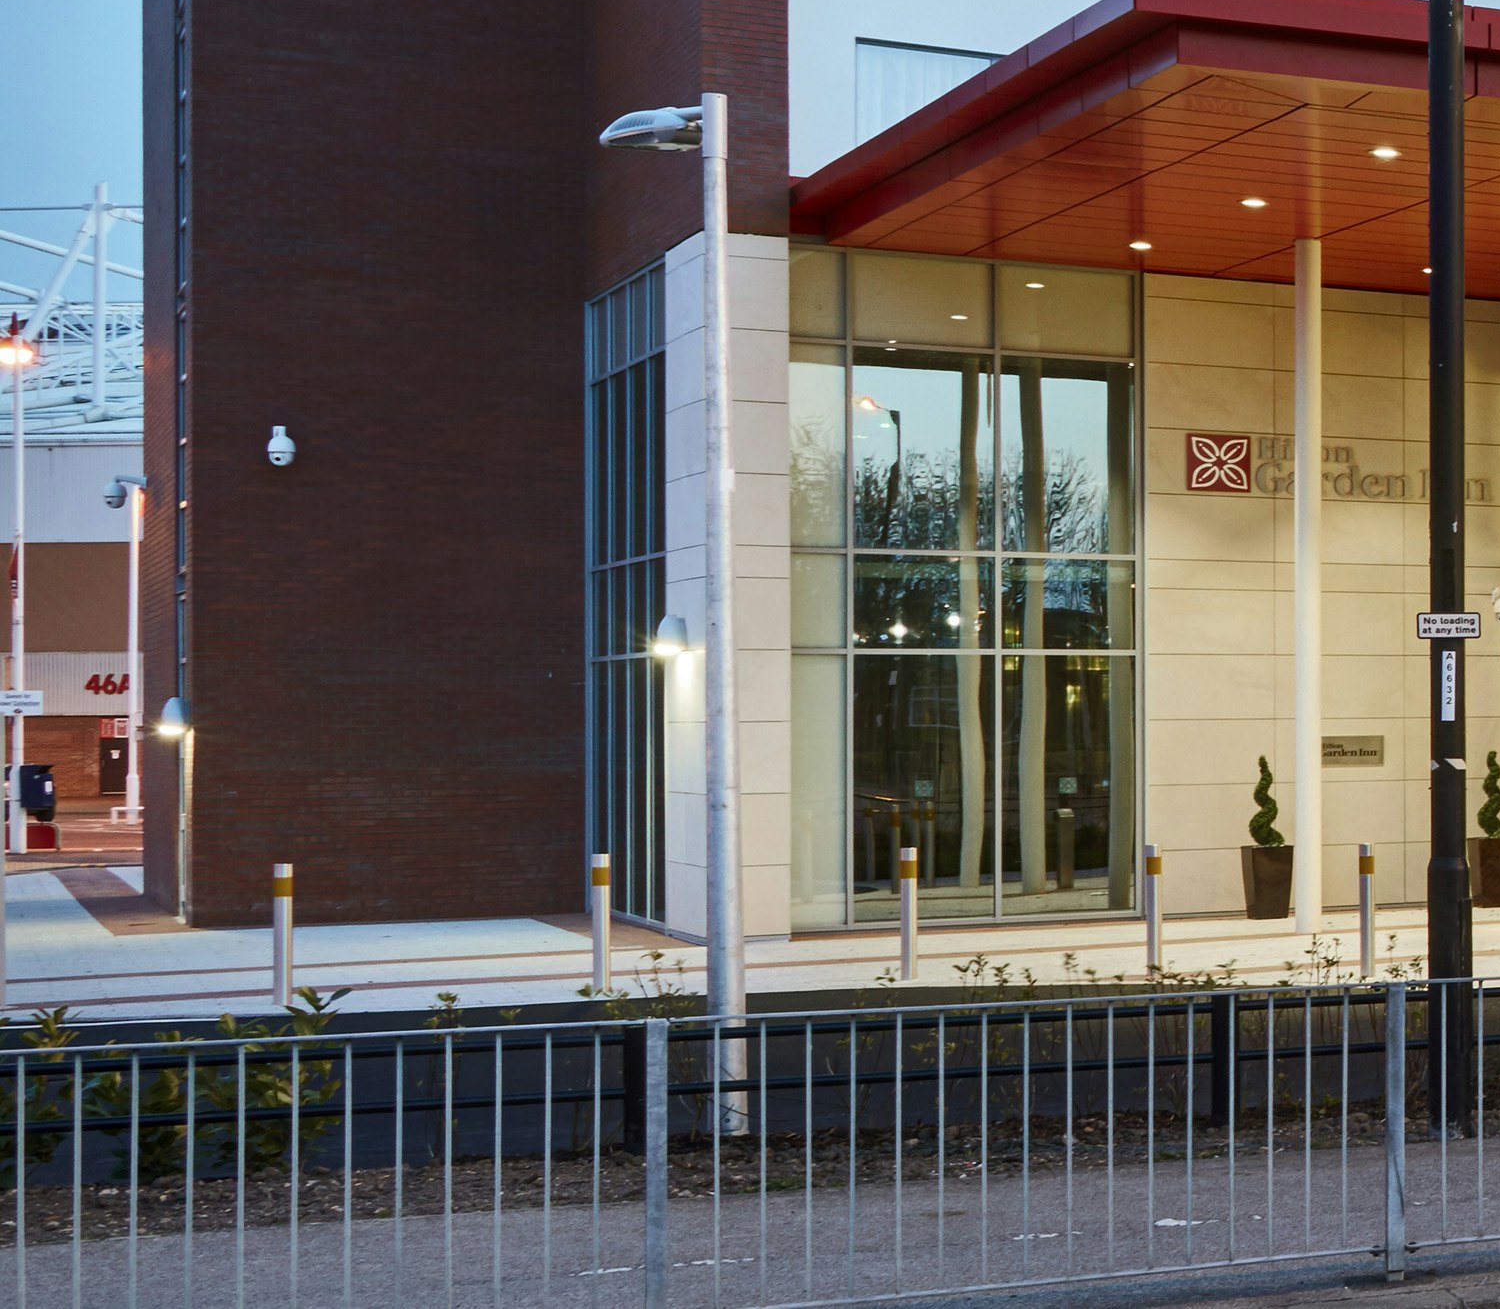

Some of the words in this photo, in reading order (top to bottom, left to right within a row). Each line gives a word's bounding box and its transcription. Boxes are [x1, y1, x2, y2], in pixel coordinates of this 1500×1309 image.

[1419, 469, 1492, 502] In
[1423, 617, 1437, 625] No
[1440, 616, 1475, 626] loading
[1435, 627, 1452, 635] any
[1455, 626, 1476, 634] time
[1359, 748, 1377, 757] Inn
